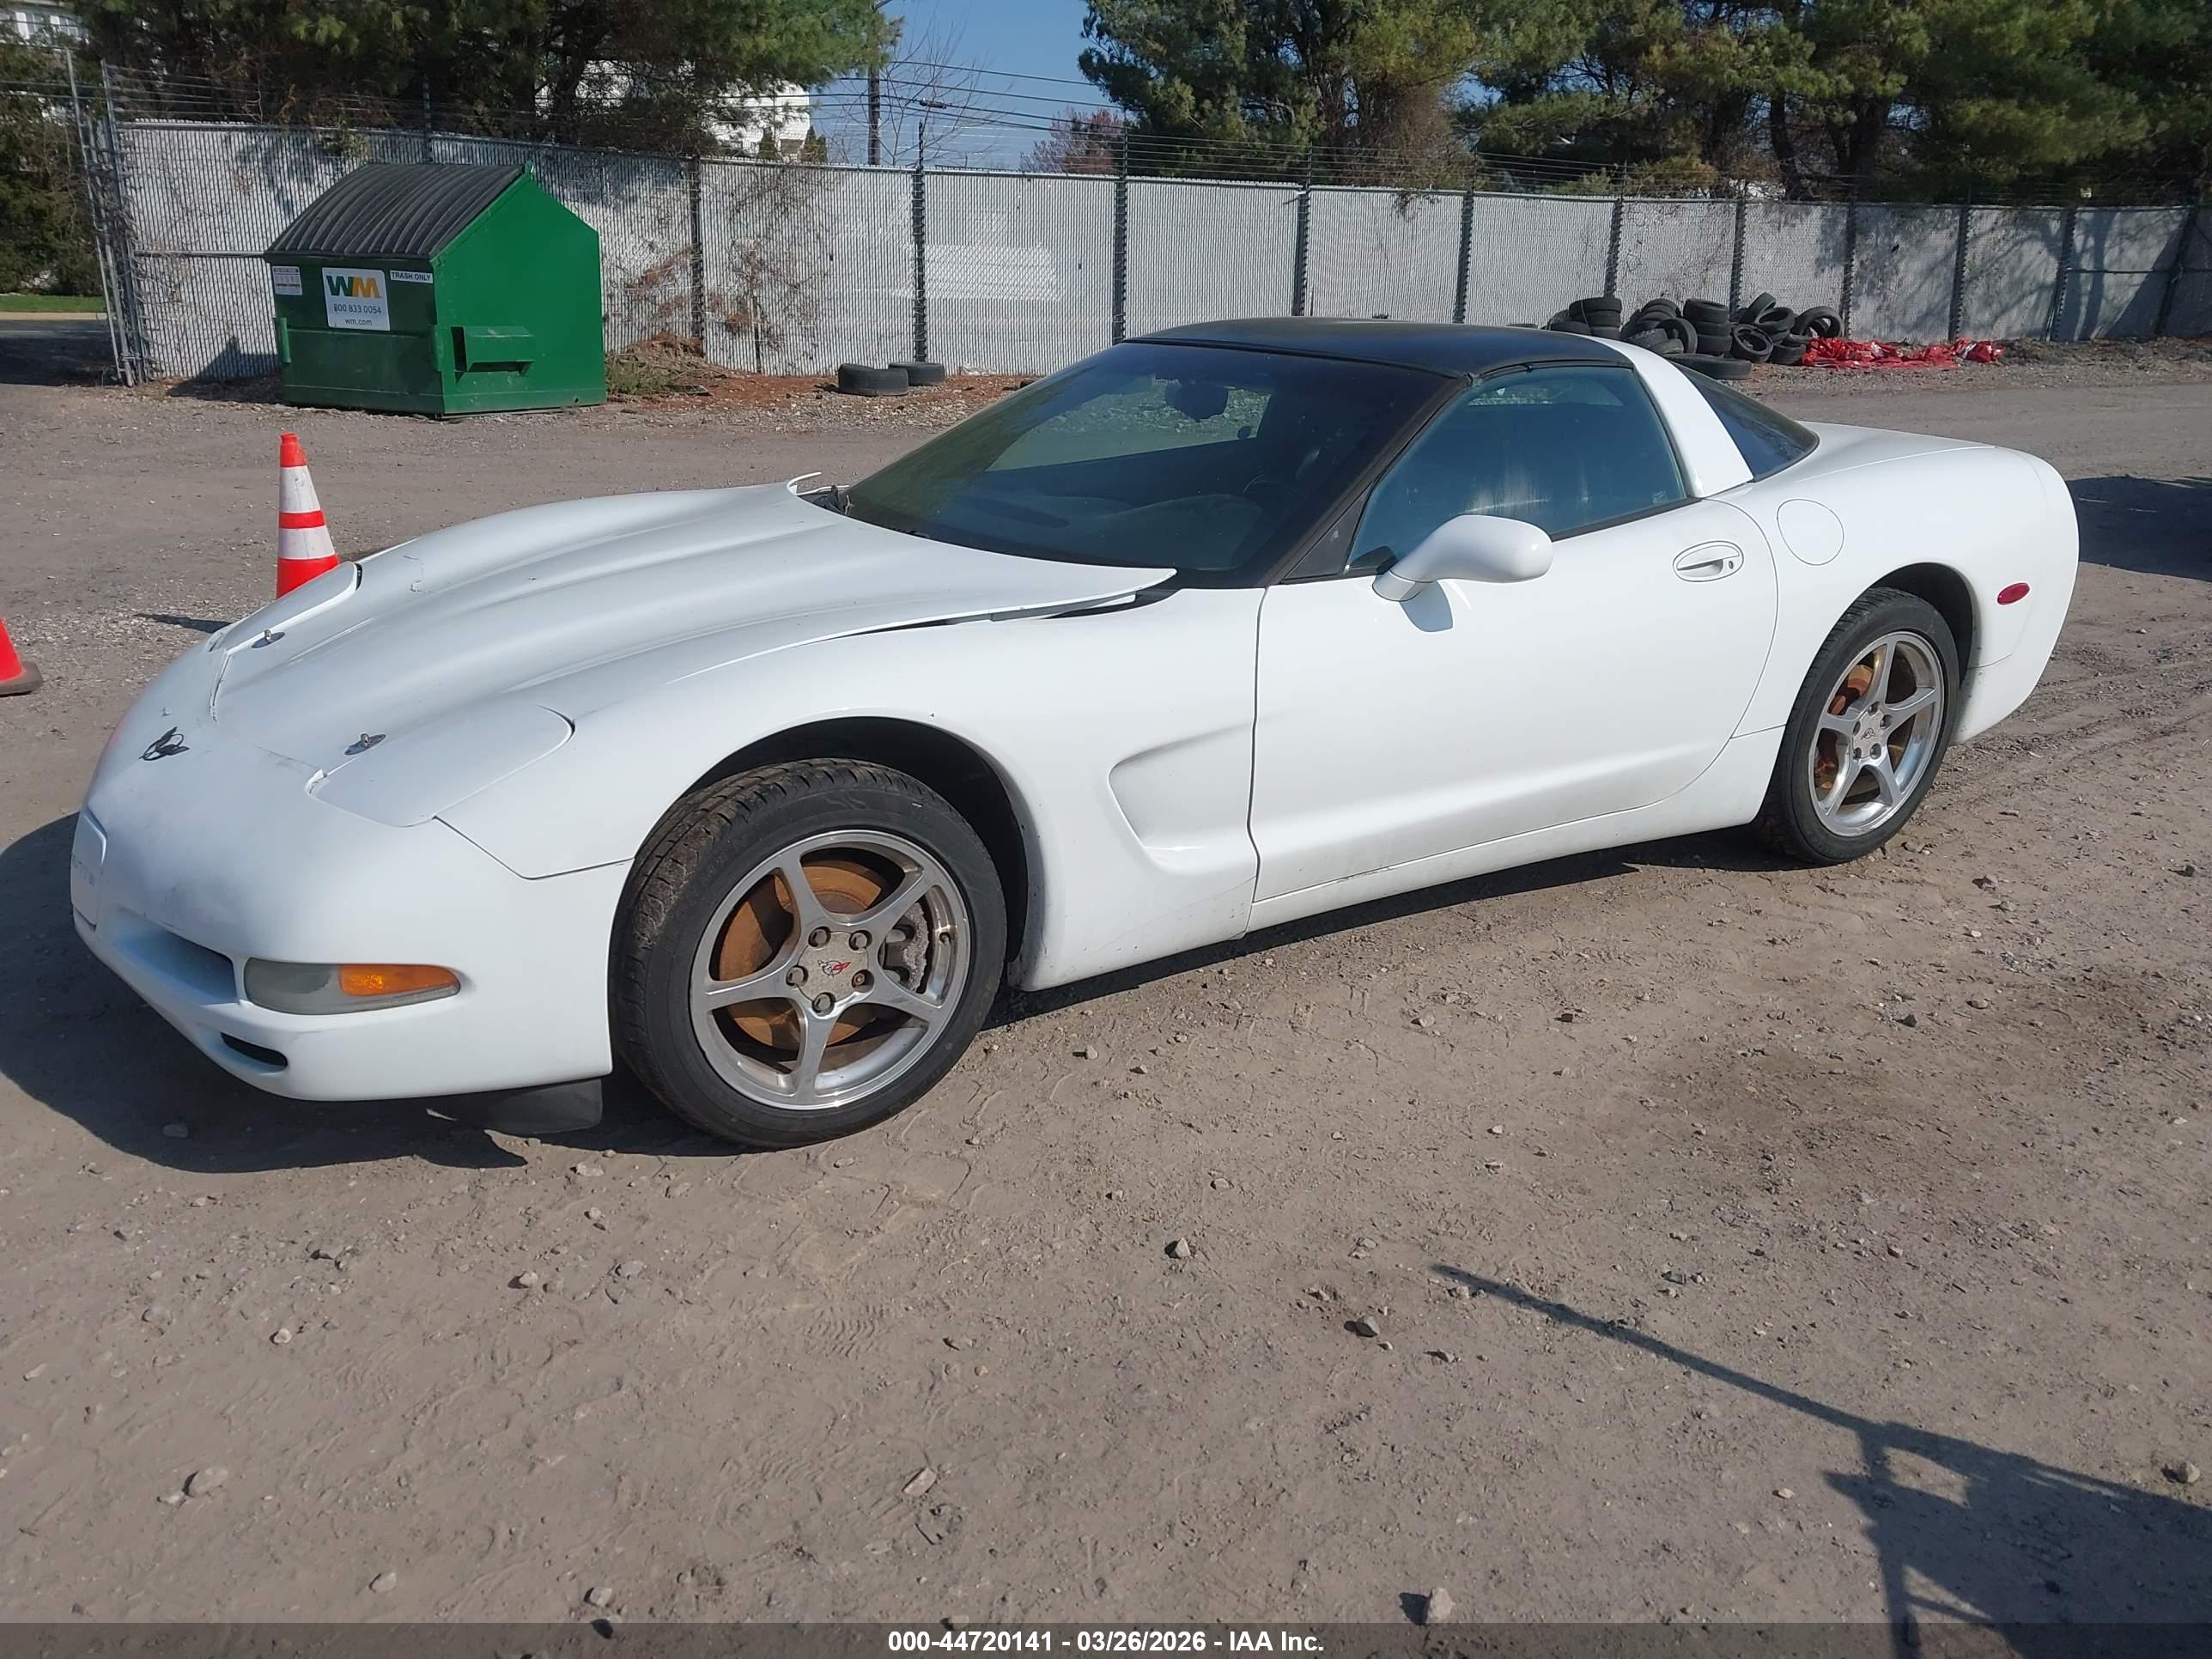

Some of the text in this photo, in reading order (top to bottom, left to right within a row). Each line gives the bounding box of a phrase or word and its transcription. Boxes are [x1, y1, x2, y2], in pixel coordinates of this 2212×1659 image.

[391, 271, 431, 283] TRASH ONLY
[326, 275, 381, 299] WM
[333, 303, 381, 314] 800 833 0054
